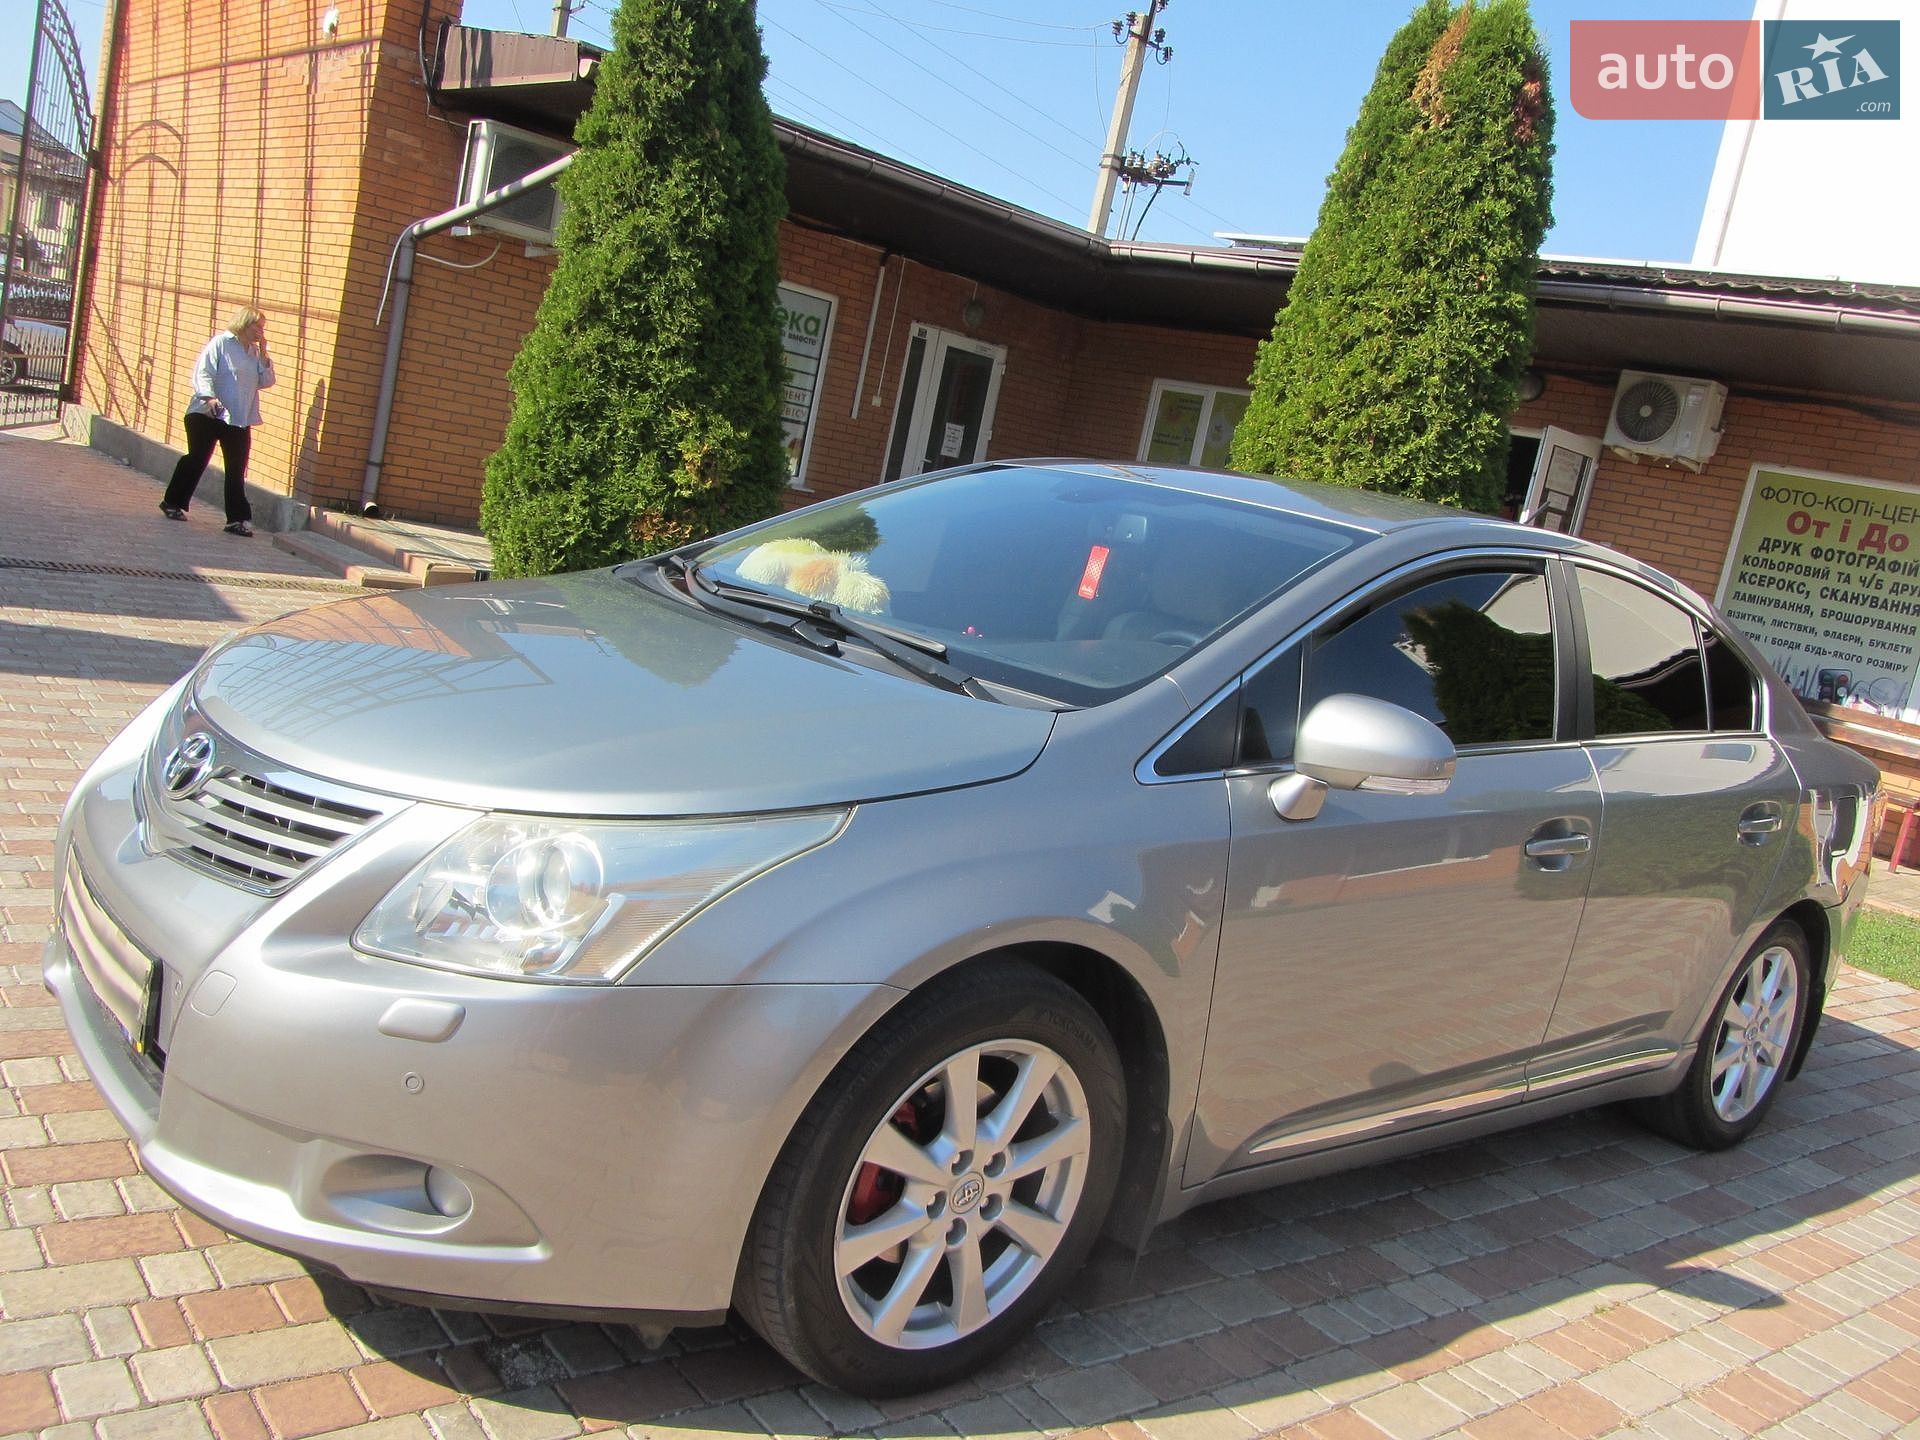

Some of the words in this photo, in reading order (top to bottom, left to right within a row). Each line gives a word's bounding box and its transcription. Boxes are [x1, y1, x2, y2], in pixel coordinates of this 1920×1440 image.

[1787, 511, 1830, 539] От
[1839, 519, 1852, 542] і
[1857, 522, 1909, 554] До
[1742, 555, 1830, 580] КОЛЬОРОВИЙ
[1837, 571, 1851, 585] ТА
[1758, 537, 1802, 557] ДРУК
[1810, 546, 1920, 577] ФОТОГРАФІЙ
[1732, 591, 1814, 618] ЛАМІНУВАННЯ,
[1821, 608, 1917, 636] БРОШОРУВАННЯ
[1738, 571, 1811, 599] КСЕРОКС,
[1820, 586, 1920, 617] СКАНУВАННЯ
[1770, 618, 1818, 637] ЛИСТІВКИ,
[1868, 639, 1912, 655] БУКЛЕТИ
[1770, 637, 1801, 651] БОРДИ
[1804, 644, 1863, 663] БУДЬ-ЯКОГО
[1866, 657, 1909, 673] РОЗМІРУ
